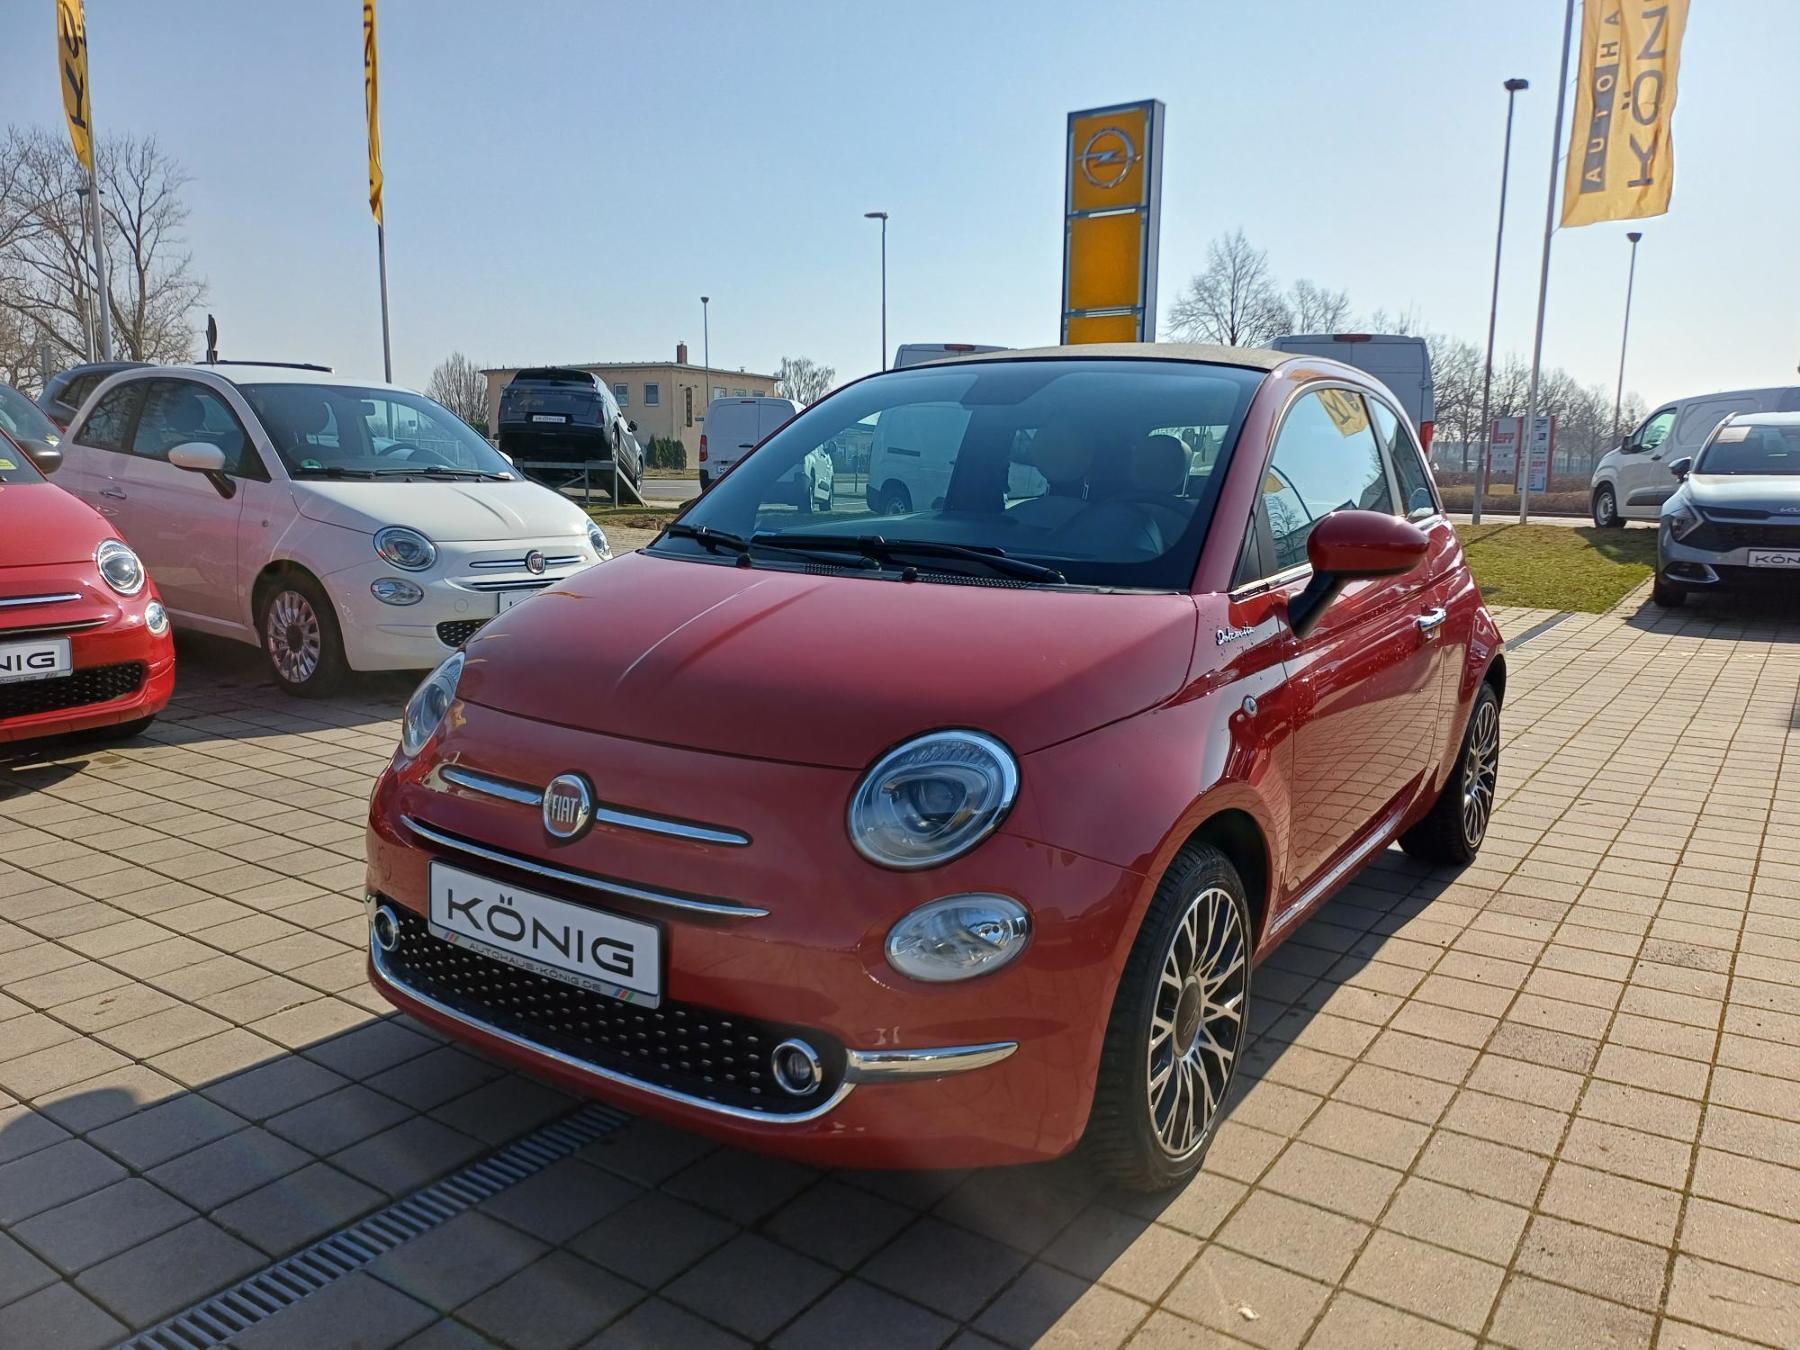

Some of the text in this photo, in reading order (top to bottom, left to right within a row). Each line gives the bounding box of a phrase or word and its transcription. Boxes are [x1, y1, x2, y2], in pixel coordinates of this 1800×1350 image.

[1621, 0, 1669, 188] KÖN
[551, 794, 579, 824] FIAT
[447, 888, 634, 978] KÖNIG
